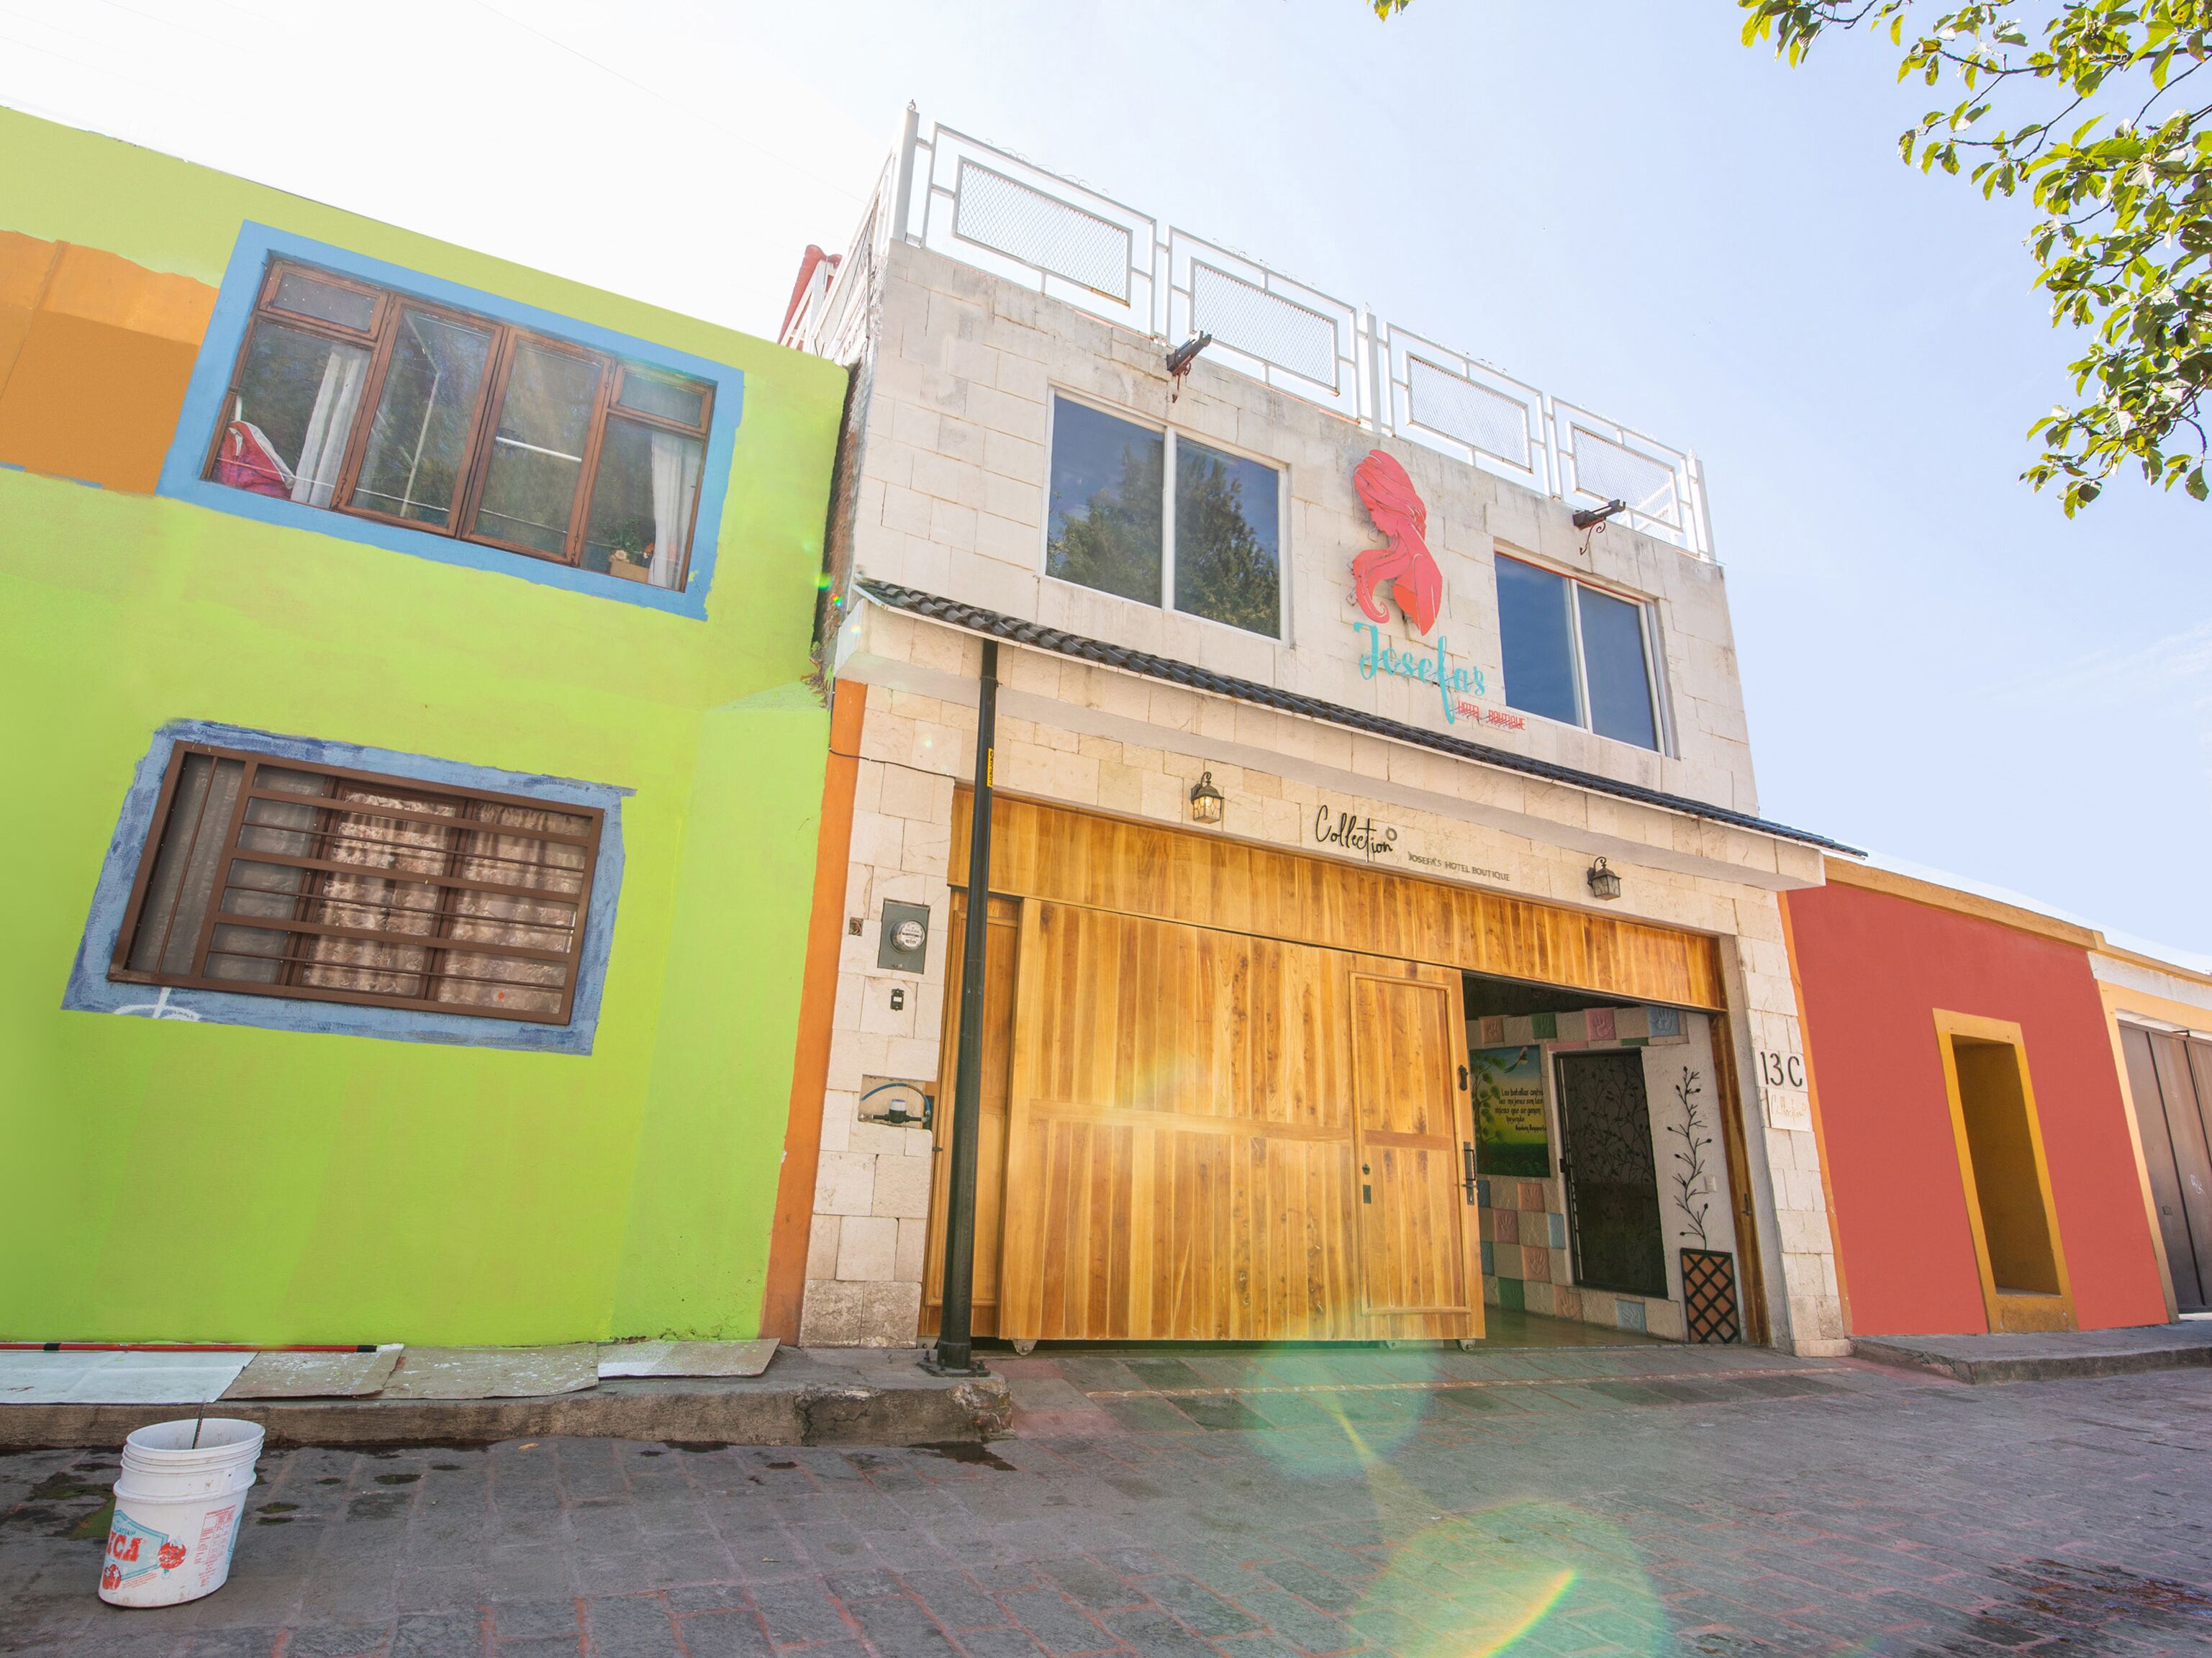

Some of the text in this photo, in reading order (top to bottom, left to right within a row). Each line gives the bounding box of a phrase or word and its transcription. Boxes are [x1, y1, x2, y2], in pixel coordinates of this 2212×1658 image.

[1458, 700, 1526, 730] HOTEL BOUTIQUE
[1315, 805, 1393, 863] Collection
[1445, 861, 1470, 873] HOTEL
[1472, 866, 1510, 882] BOUTIQUE
